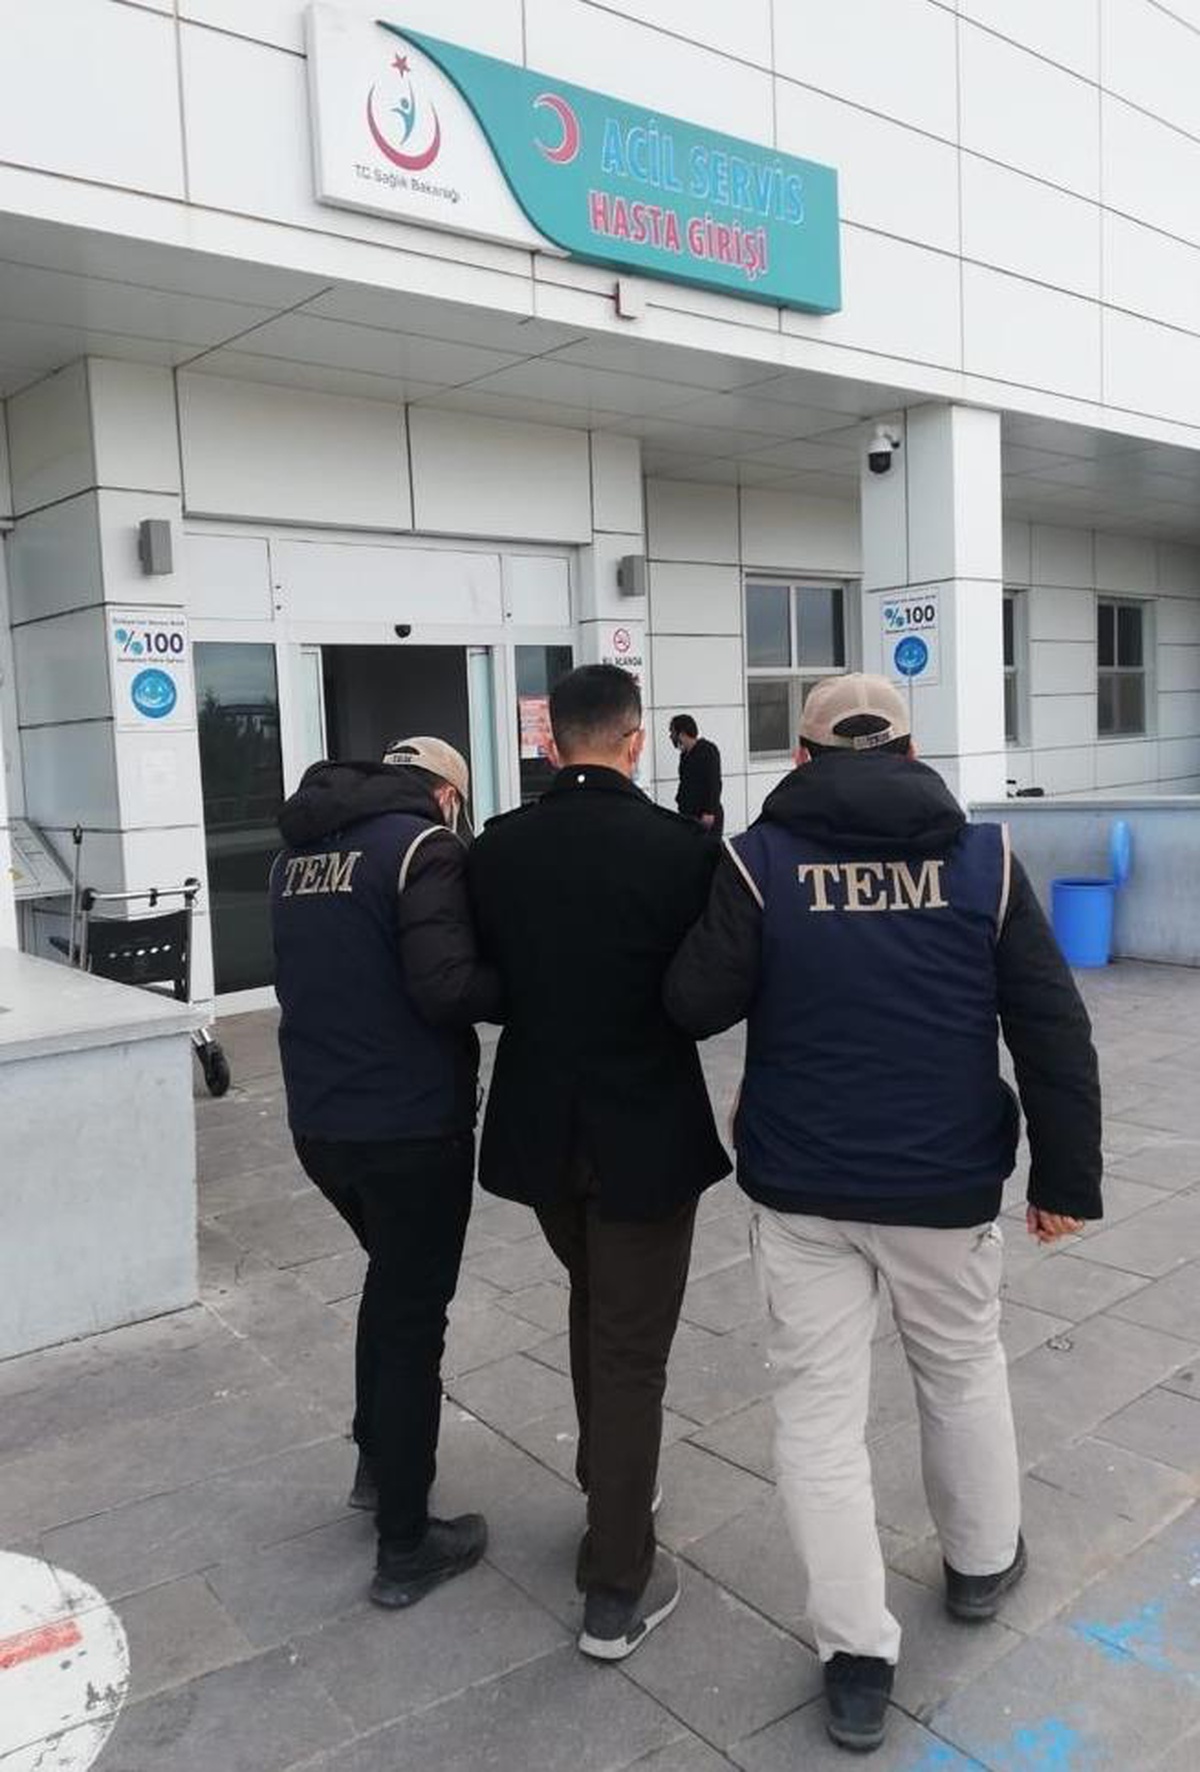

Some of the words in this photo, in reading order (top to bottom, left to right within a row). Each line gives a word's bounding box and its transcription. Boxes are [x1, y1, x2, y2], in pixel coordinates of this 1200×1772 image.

[602, 118, 682, 192] ACİL
[690, 146, 804, 225] SERVİS
[589, 190, 681, 254] HASTA
[688, 212, 768, 281] GİRİŞİ
[885, 605, 935, 628] %100
[115, 628, 183, 655] %100
[282, 852, 362, 897] TEM
[798, 860, 949, 911] TEM
